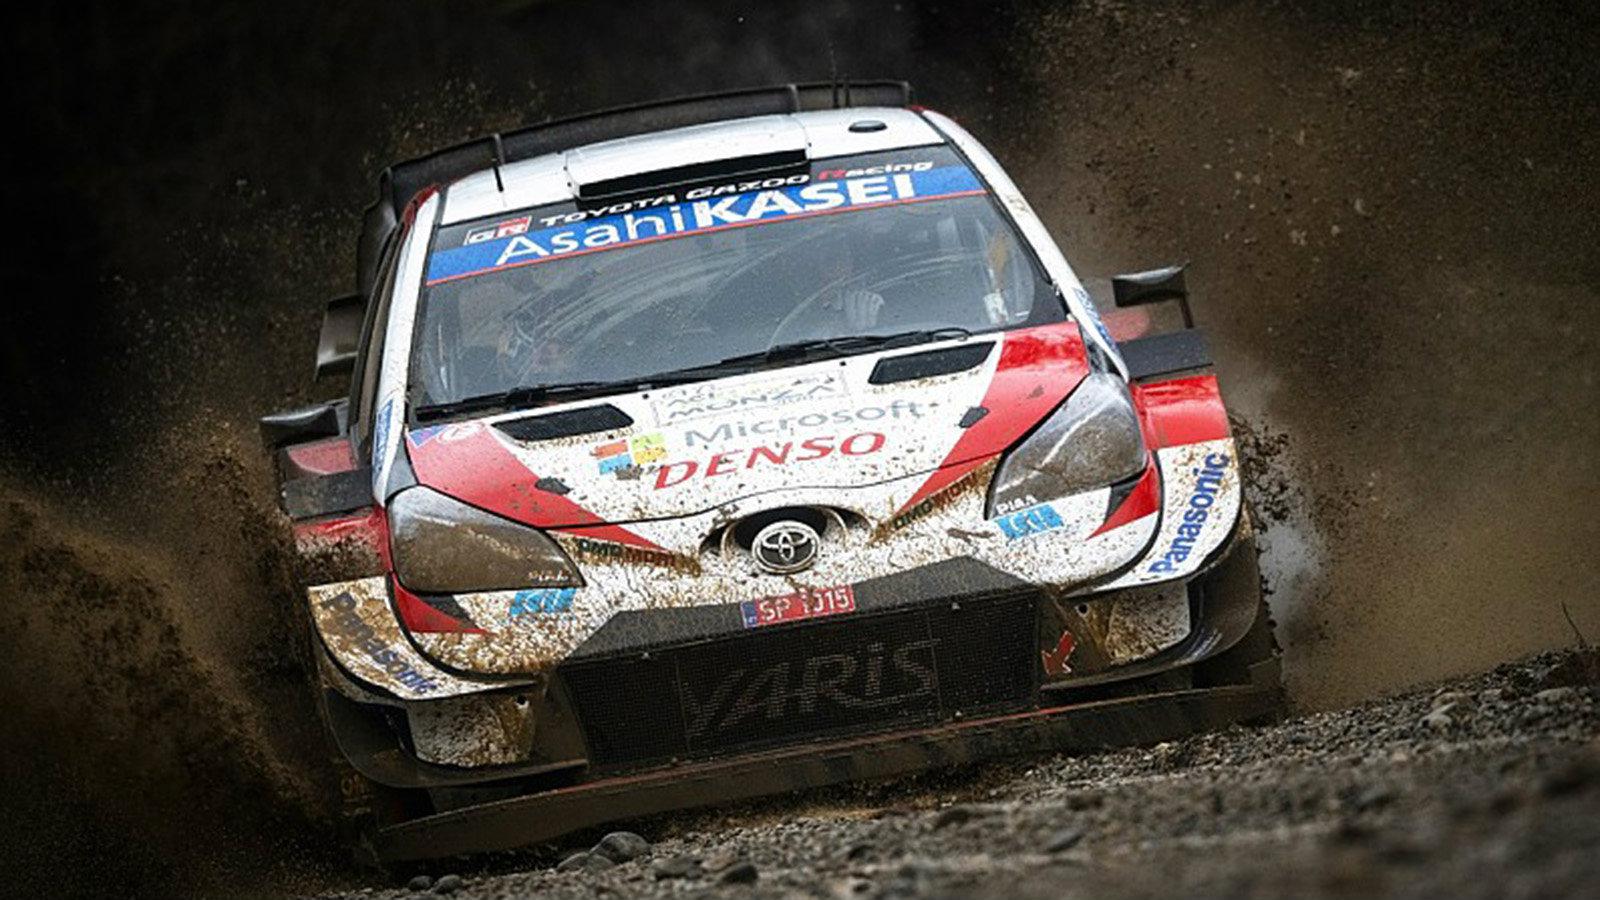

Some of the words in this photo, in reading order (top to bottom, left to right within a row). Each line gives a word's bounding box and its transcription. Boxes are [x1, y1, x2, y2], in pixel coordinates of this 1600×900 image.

[540, 195, 675, 226] TOYOTA
[686, 173, 810, 199] GAZOO
[817, 161, 934, 180] Racing
[684, 399, 923, 446] Microsoft
[653, 432, 886, 490] DENSO
[1147, 453, 1230, 573] Panasonic
[759, 597, 791, 621] SP
